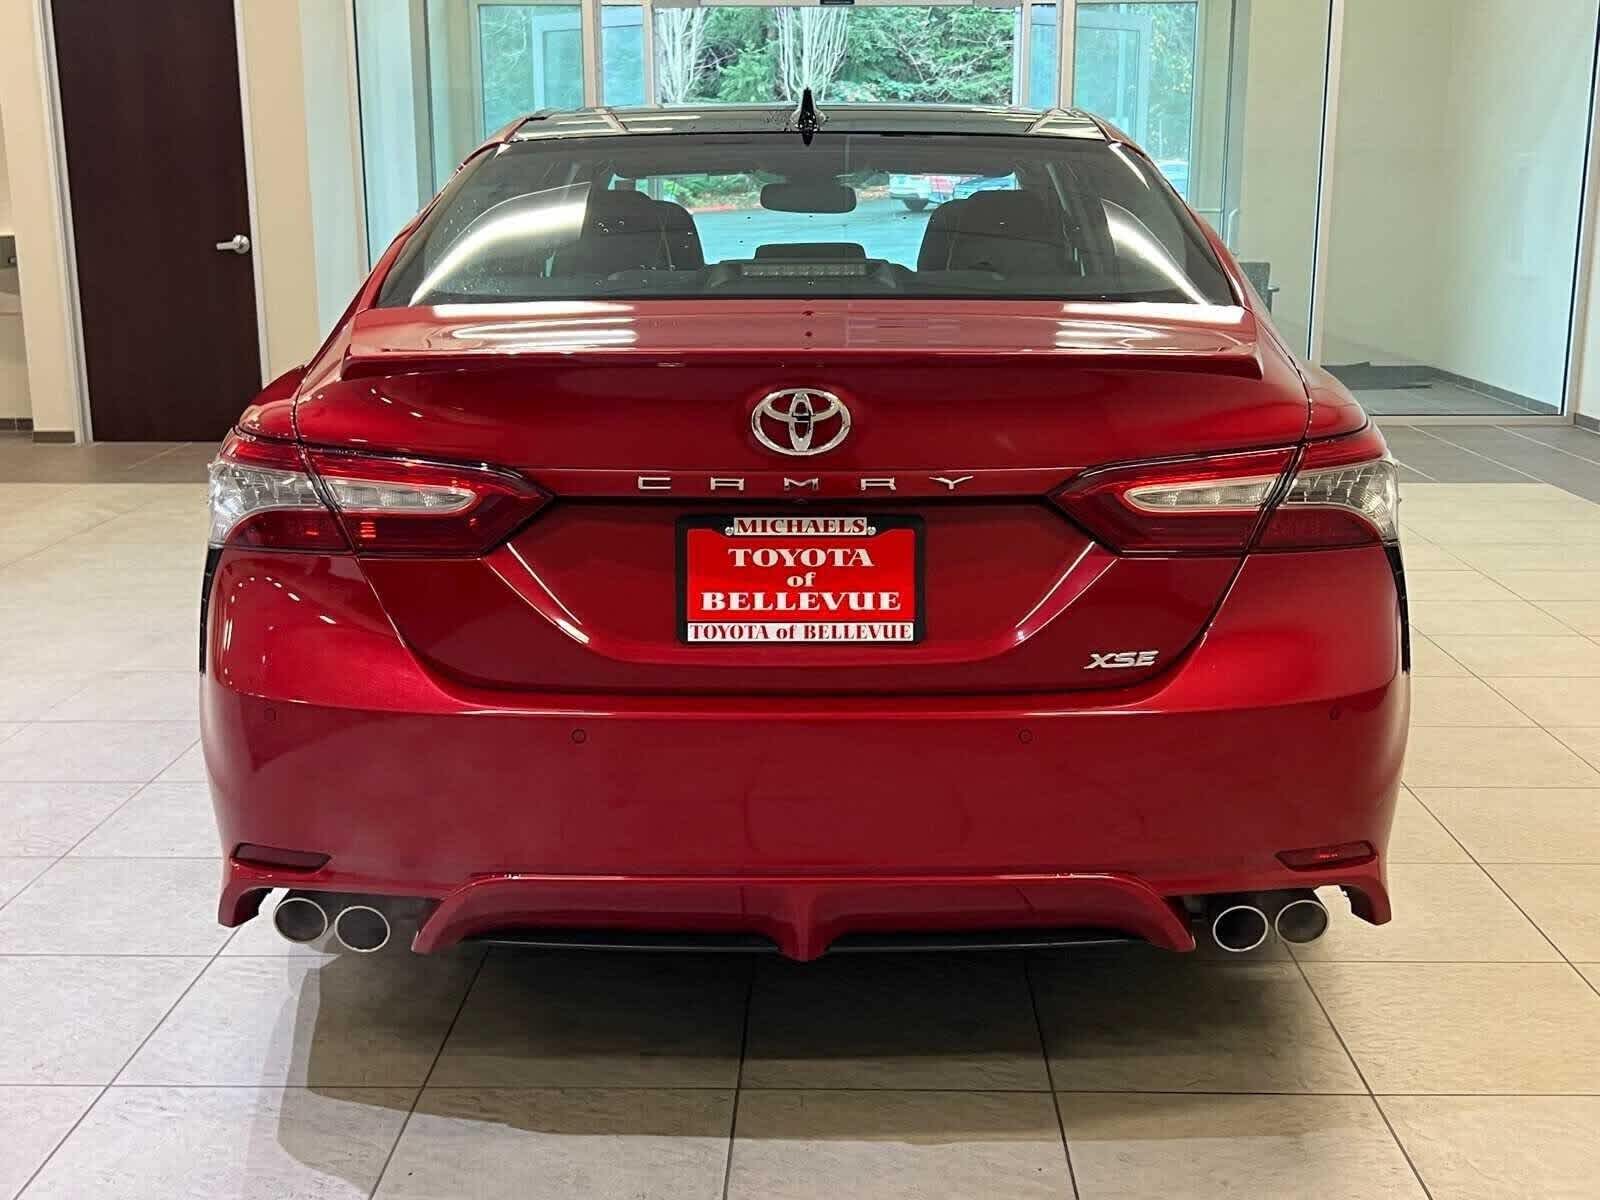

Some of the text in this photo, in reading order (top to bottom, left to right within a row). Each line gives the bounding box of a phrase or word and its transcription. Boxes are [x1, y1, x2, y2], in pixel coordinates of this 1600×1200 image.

[637, 475, 974, 491] CAMRY
[737, 519, 865, 534] MICHAELS
[728, 548, 875, 567] TOYOTA
[786, 571, 816, 587] of
[701, 591, 901, 611] BELLEVUE
[689, 624, 912, 640] TOYOTA of BELLEVUE
[1083, 650, 1159, 669] XSE
